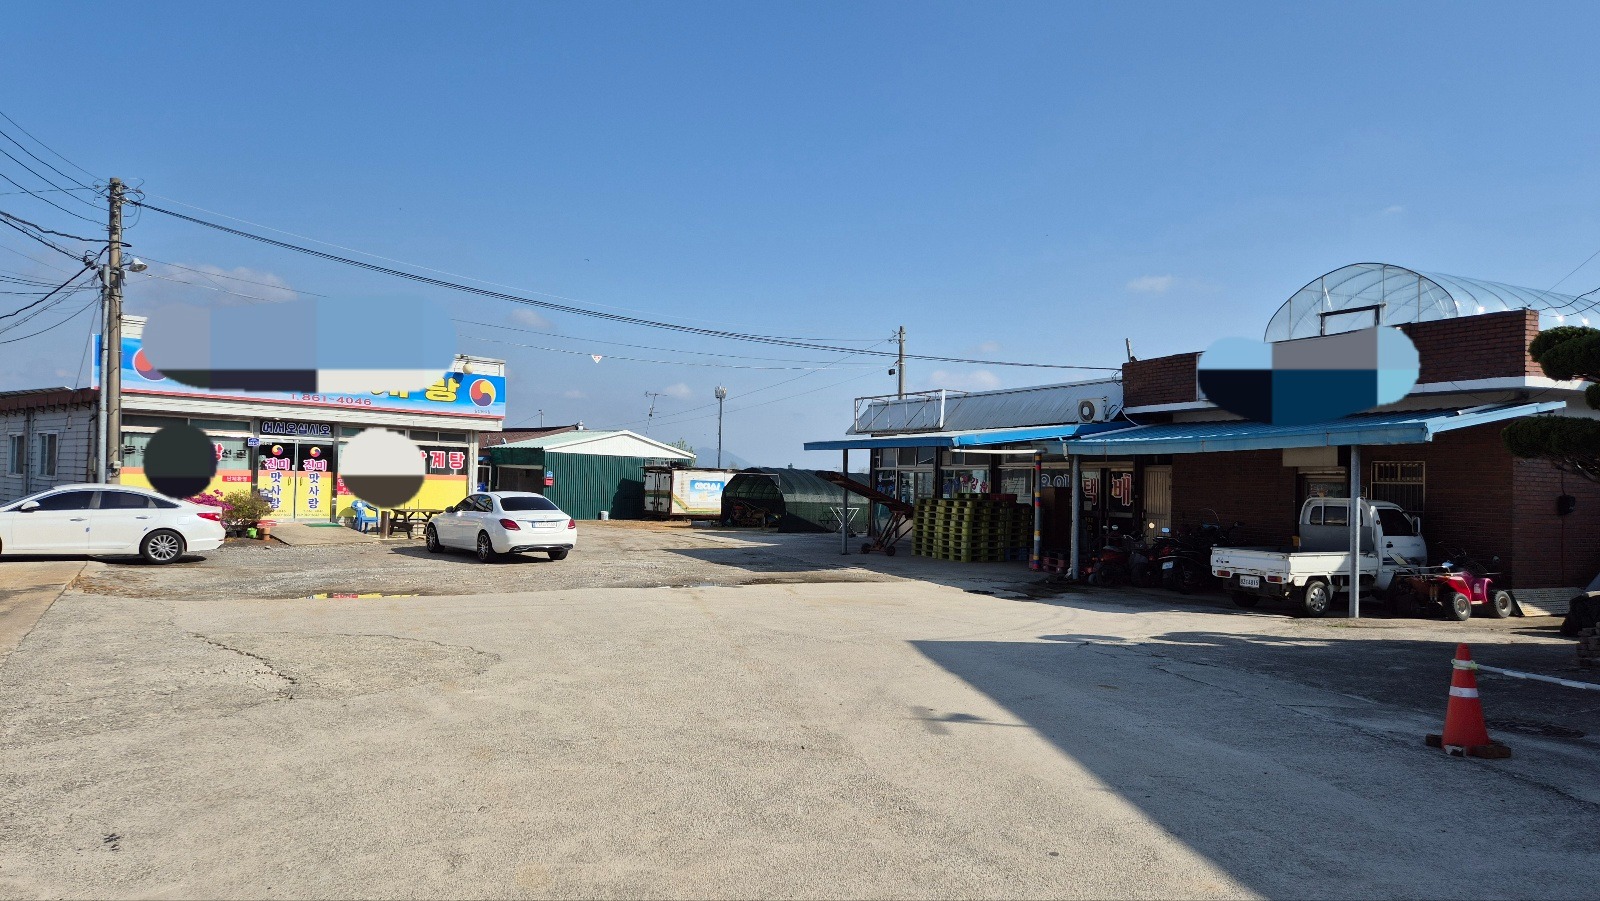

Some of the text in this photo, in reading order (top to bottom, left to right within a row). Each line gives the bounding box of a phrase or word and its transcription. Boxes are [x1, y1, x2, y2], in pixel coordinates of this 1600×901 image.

[262, 421, 331, 436] 어서오십시오
[264, 457, 290, 471] 진미
[303, 458, 328, 472] 진미
[420, 450, 466, 469] 계탕
[270, 471, 282, 509] 맛사랑
[308, 472, 320, 509] 맛사랑
[1082, 473, 1132, 506] 택배
